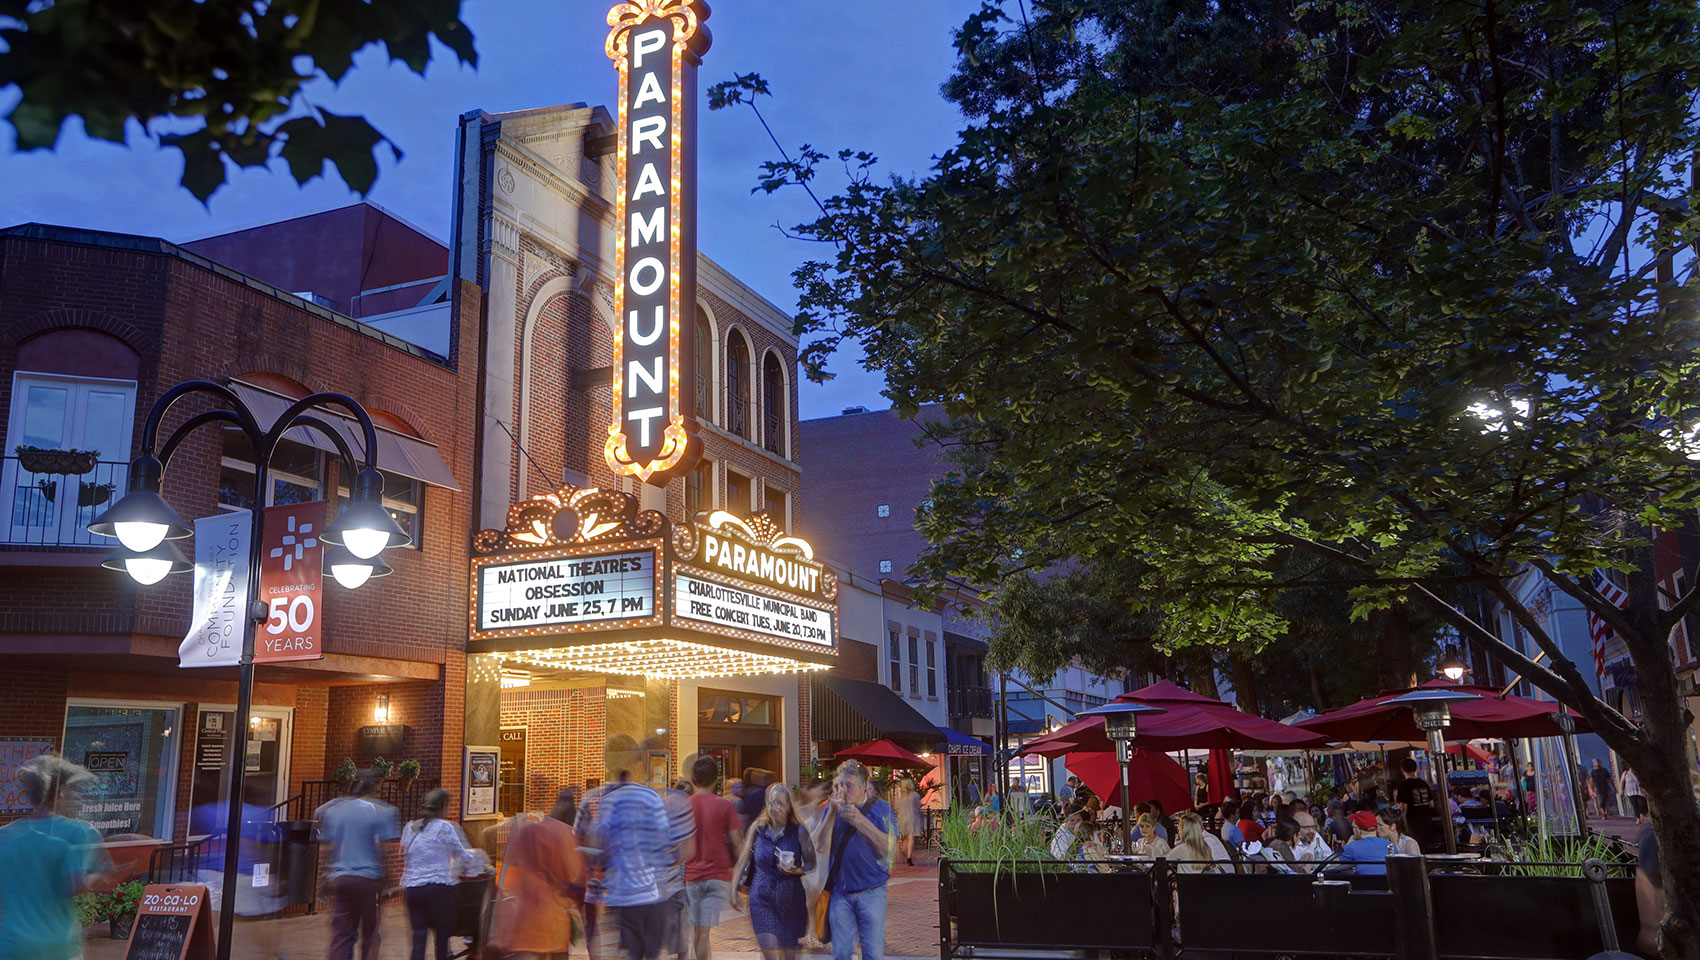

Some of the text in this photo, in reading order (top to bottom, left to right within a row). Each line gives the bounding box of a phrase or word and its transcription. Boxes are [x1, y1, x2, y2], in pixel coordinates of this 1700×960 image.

[628, 29, 668, 448] PARAMOUNT
[498, 557, 642, 584] NATIONAL THEATRE'S
[705, 534, 819, 593] PARAMOUNT
[268, 583, 316, 595] CELEBRATING
[525, 580, 604, 600] OBSESSION
[490, 596, 643, 623] SUNDAY JUNE 25, 7 PM
[688, 580, 818, 623] CHARLOTTESVILLE MUNICIPAL BAND
[266, 594, 315, 635] 50
[690, 600, 712, 617] FREE
[715, 606, 750, 625] CONCERT
[752, 613, 773, 631] TUES,
[773, 619, 791, 634] JUNE
[816, 628, 827, 641] PM
[264, 637, 314, 653] YEARS
[503, 732, 523, 741] CALL
[0, 745, 37, 760] THE
[90, 757, 126, 769] OPEN
[82, 801, 141, 813] Fresh Juice Here
[89, 818, 131, 830] Smoothies!
